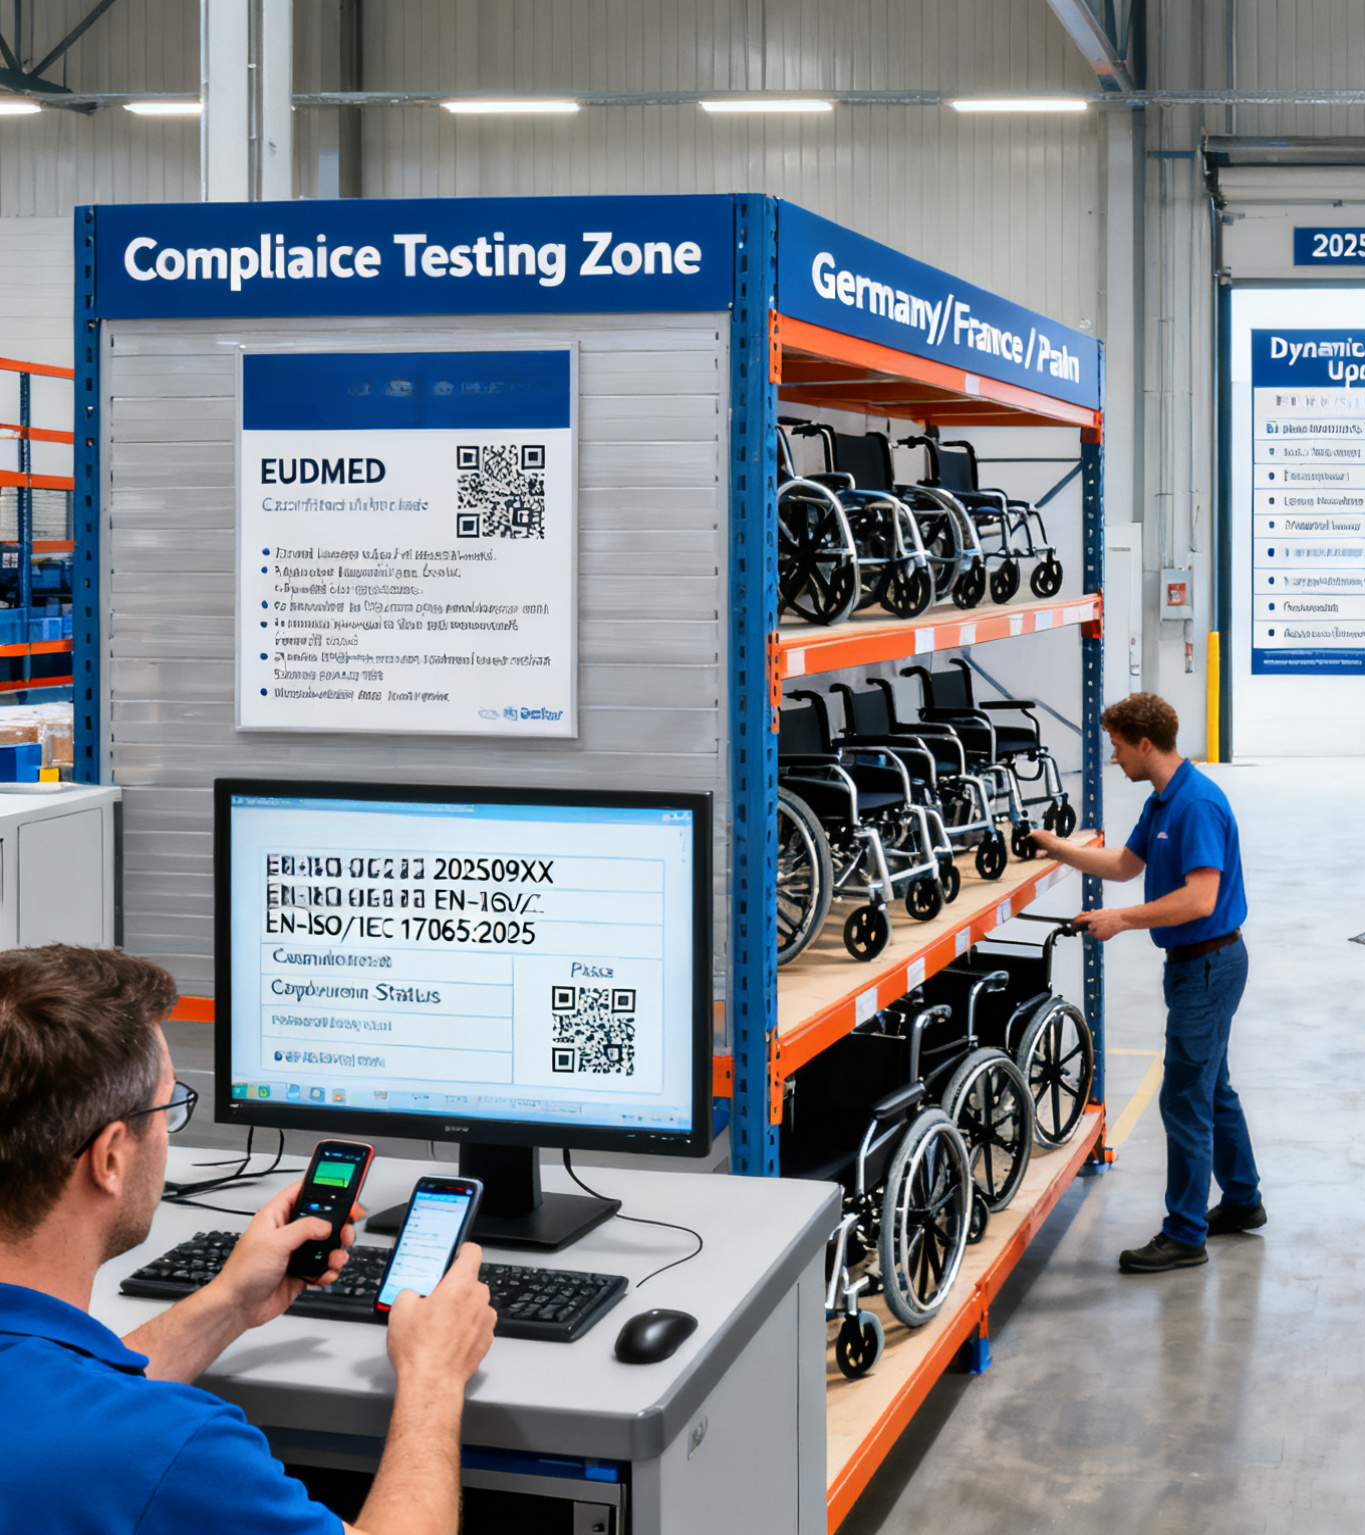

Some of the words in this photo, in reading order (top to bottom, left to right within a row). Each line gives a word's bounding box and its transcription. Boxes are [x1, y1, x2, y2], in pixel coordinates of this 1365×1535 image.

[394, 232, 567, 286] Testing
[579, 232, 703, 276] Zone
[261, 457, 386, 485] EUDMED
